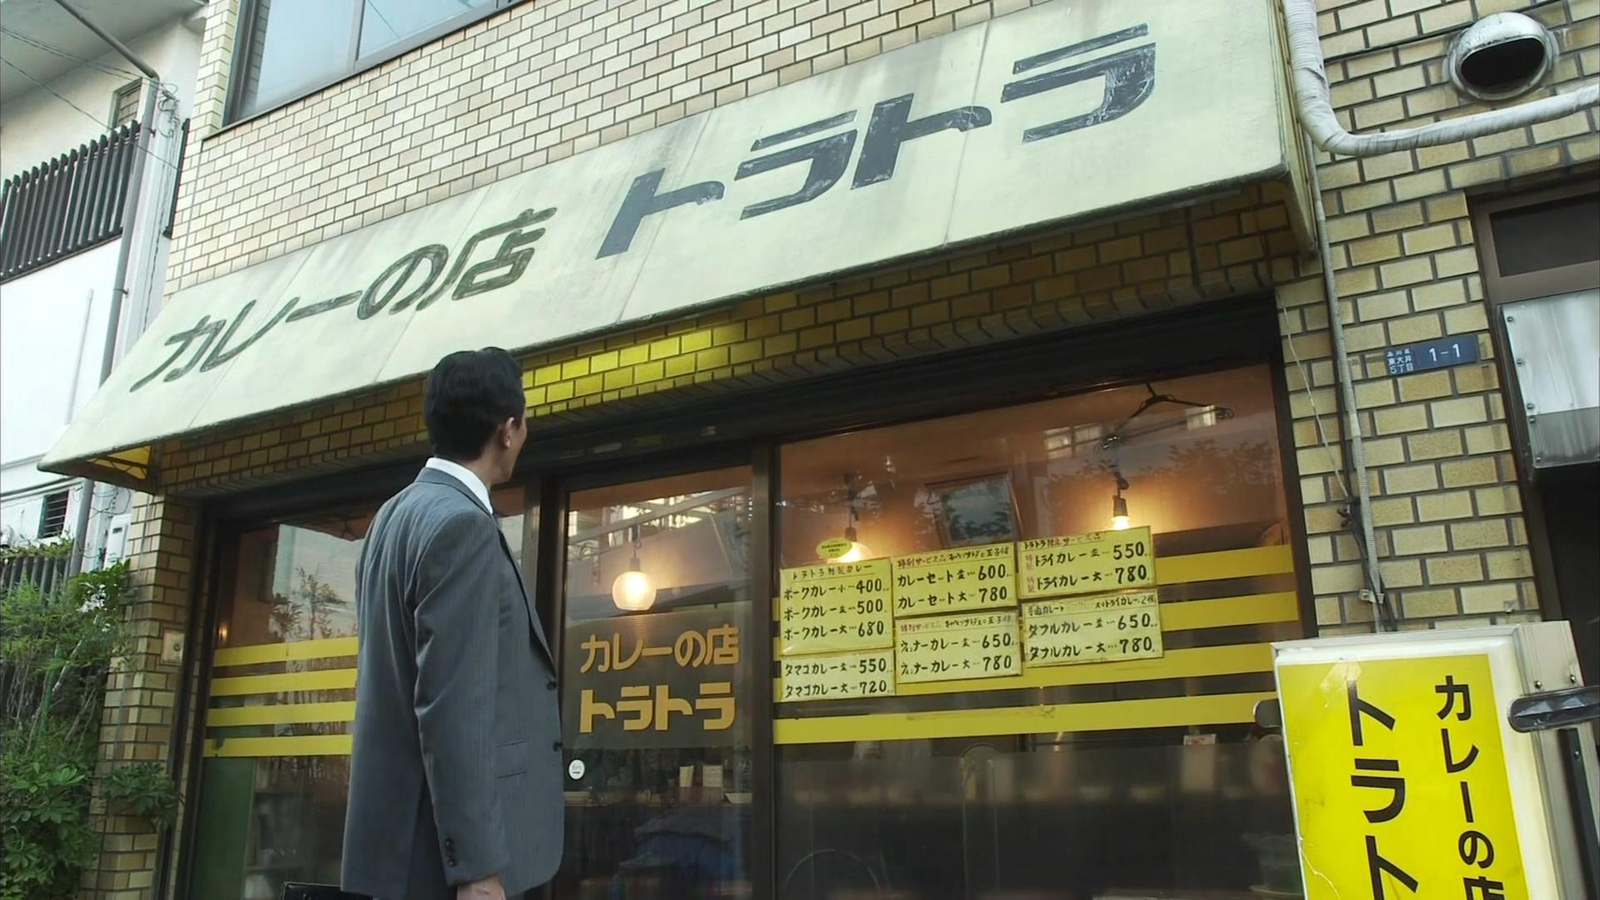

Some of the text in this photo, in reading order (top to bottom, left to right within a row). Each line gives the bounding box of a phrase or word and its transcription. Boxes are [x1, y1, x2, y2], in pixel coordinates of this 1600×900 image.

[130, 22, 1156, 392] カレーの店 トラトラ
[1388, 355, 1412, 365] 東大井
[1429, 343, 1461, 362] 1-1
[1389, 363, 1414, 374] 5丁目
[1113, 541, 1144, 560] 550
[978, 564, 1006, 581] 600
[1115, 565, 1147, 584] 780
[856, 578, 882, 594] 400
[979, 586, 1007, 603] 780
[857, 599, 883, 615] 500
[858, 621, 884, 637] 680
[1118, 613, 1150, 630] 650
[580, 624, 739, 673] カレーの店
[982, 633, 1011, 648] 650
[1120, 637, 1152, 654] 780
[859, 658, 887, 673] 550
[983, 655, 1012, 671] 780
[860, 680, 887, 694] 720
[580, 682, 735, 733] トラトラ
